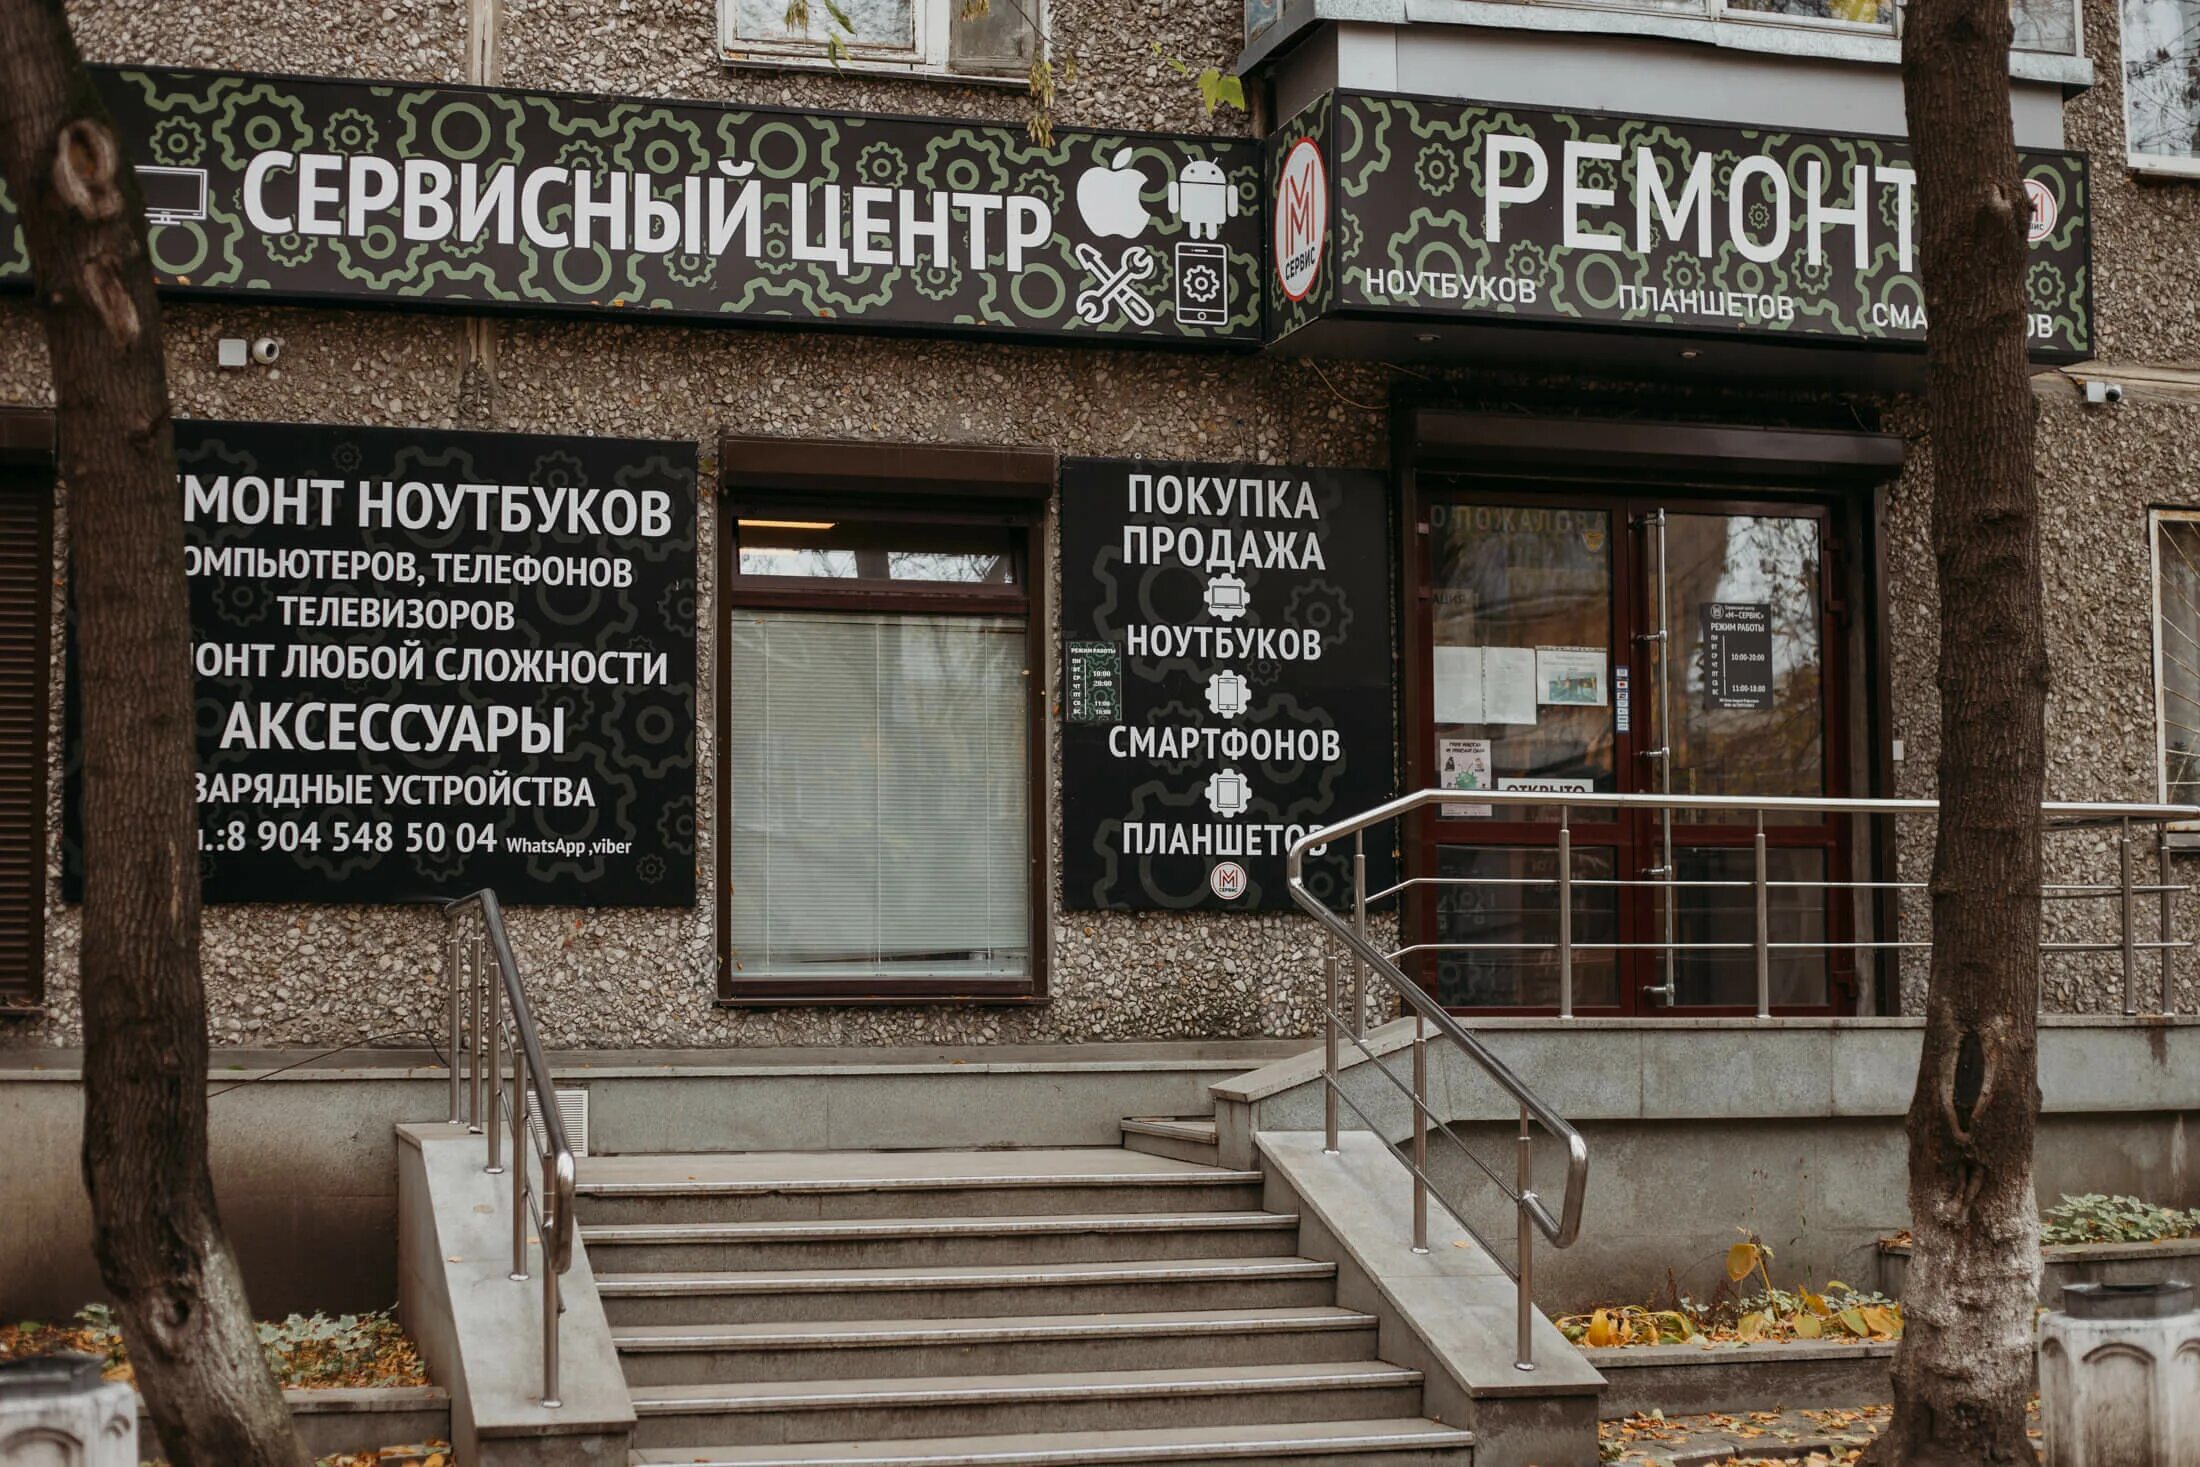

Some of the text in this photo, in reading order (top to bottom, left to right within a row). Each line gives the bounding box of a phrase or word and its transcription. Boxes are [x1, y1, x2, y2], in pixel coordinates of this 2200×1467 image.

[243, 149, 1053, 275] СЕРВИСНЫЙ ЦЕНТР
[1485, 133, 1917, 272] РЕМОНТ
[1285, 246, 1316, 281] СЕРВИС
[1365, 267, 1537, 304] НОУТБУКОВ
[1618, 284, 1795, 321] ПЛАНШЕТОВ
[176, 474, 672, 537] МОНТ НОУТБУКОВ
[1128, 474, 1320, 520] ПОКУПКА
[1123, 525, 1326, 573] ПРОДАЖА
[431, 553, 633, 588] ТЕЛЕФОНОВ
[277, 595, 515, 631] ТЕЛЕВИЗОРОВ
[1710, 622, 1765, 633] РЕЖИМ РАБОТЫ
[190, 639, 667, 685] ОНТ ЛЮБОЙ СЛОЖНОСТИ
[1127, 624, 1322, 661] НОУТБУКОВ
[1731, 653, 1765, 661] 10:00-20:00
[219, 701, 565, 754] АКСЕССУАРЫ
[1109, 725, 1340, 761] СМАРТФОНОВ
[194, 769, 596, 809] ЗАРЯДНЫЕ УСТРОЙСТВА
[257, 820, 321, 852] 904
[332, 821, 393, 852] 548
[406, 822, 446, 853] 50
[455, 822, 498, 853] 04
[506, 837, 586, 858] WhatsApp
[1123, 822, 1327, 857] ПЛАНШЕТОВ
